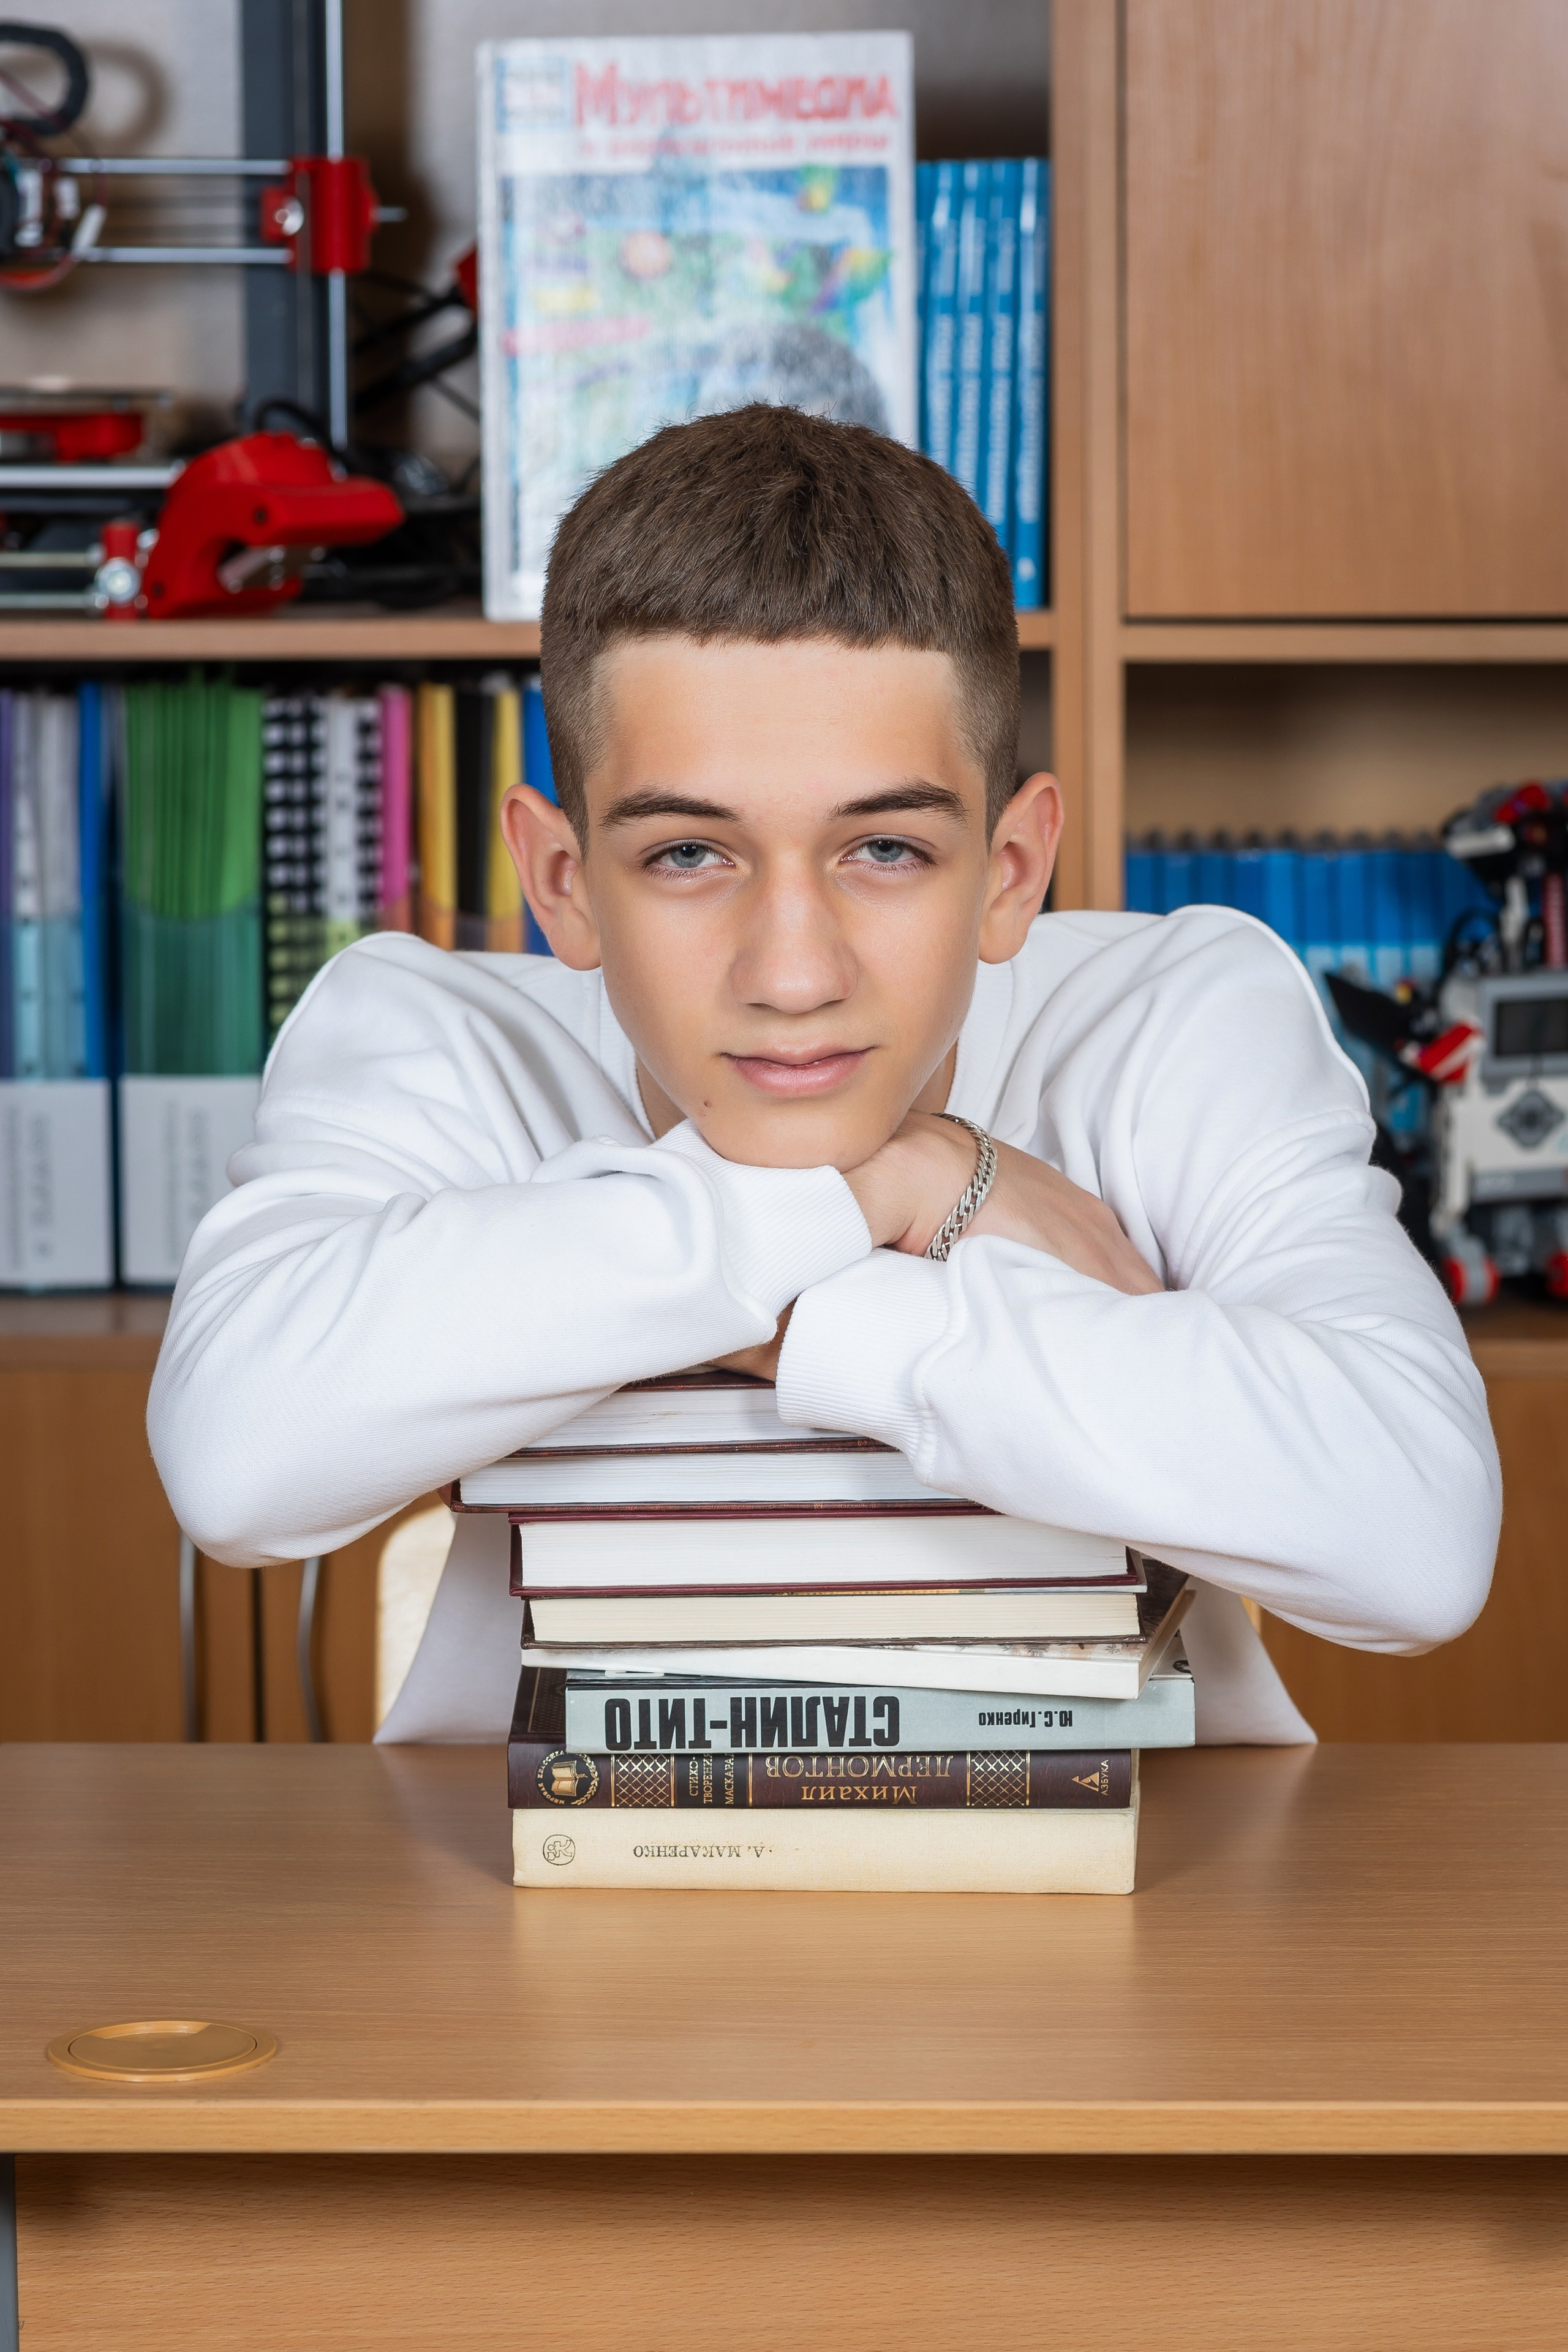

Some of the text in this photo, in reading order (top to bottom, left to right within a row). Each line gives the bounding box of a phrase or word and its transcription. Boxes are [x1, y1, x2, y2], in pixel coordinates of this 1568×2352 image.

[605, 1696, 900, 1751] СТАЛИН-ТИТО
[765, 1755, 954, 1777] ЛЕРМОНТОВ
[1100, 1759, 1109, 1796] АЗБУКА
[801, 1785, 918, 1804] Михаил
[633, 1844, 742, 1858] МАКАРЕНКО
